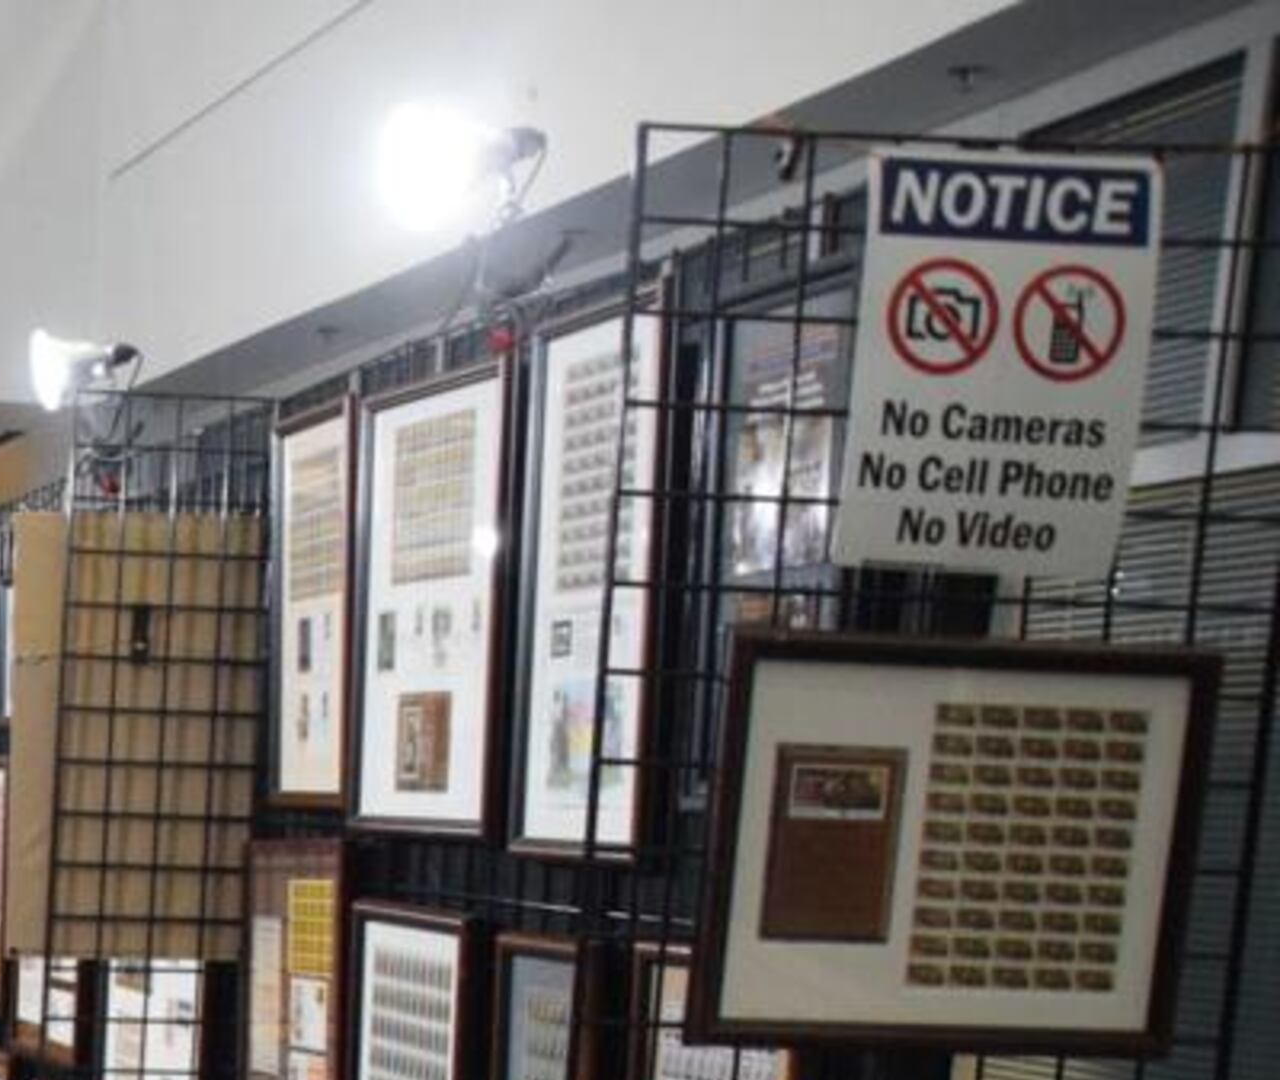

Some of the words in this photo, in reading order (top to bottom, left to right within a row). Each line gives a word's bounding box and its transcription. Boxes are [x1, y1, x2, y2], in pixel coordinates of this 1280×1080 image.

[891, 169, 1138, 235] NOTICE
[881, 399, 929, 438] No
[942, 402, 1106, 448] Cameras
[858, 453, 906, 491] No
[918, 455, 988, 495] Cell
[999, 460, 1114, 500] Phone
[897, 508, 946, 545] No
[957, 511, 1056, 551] Video
